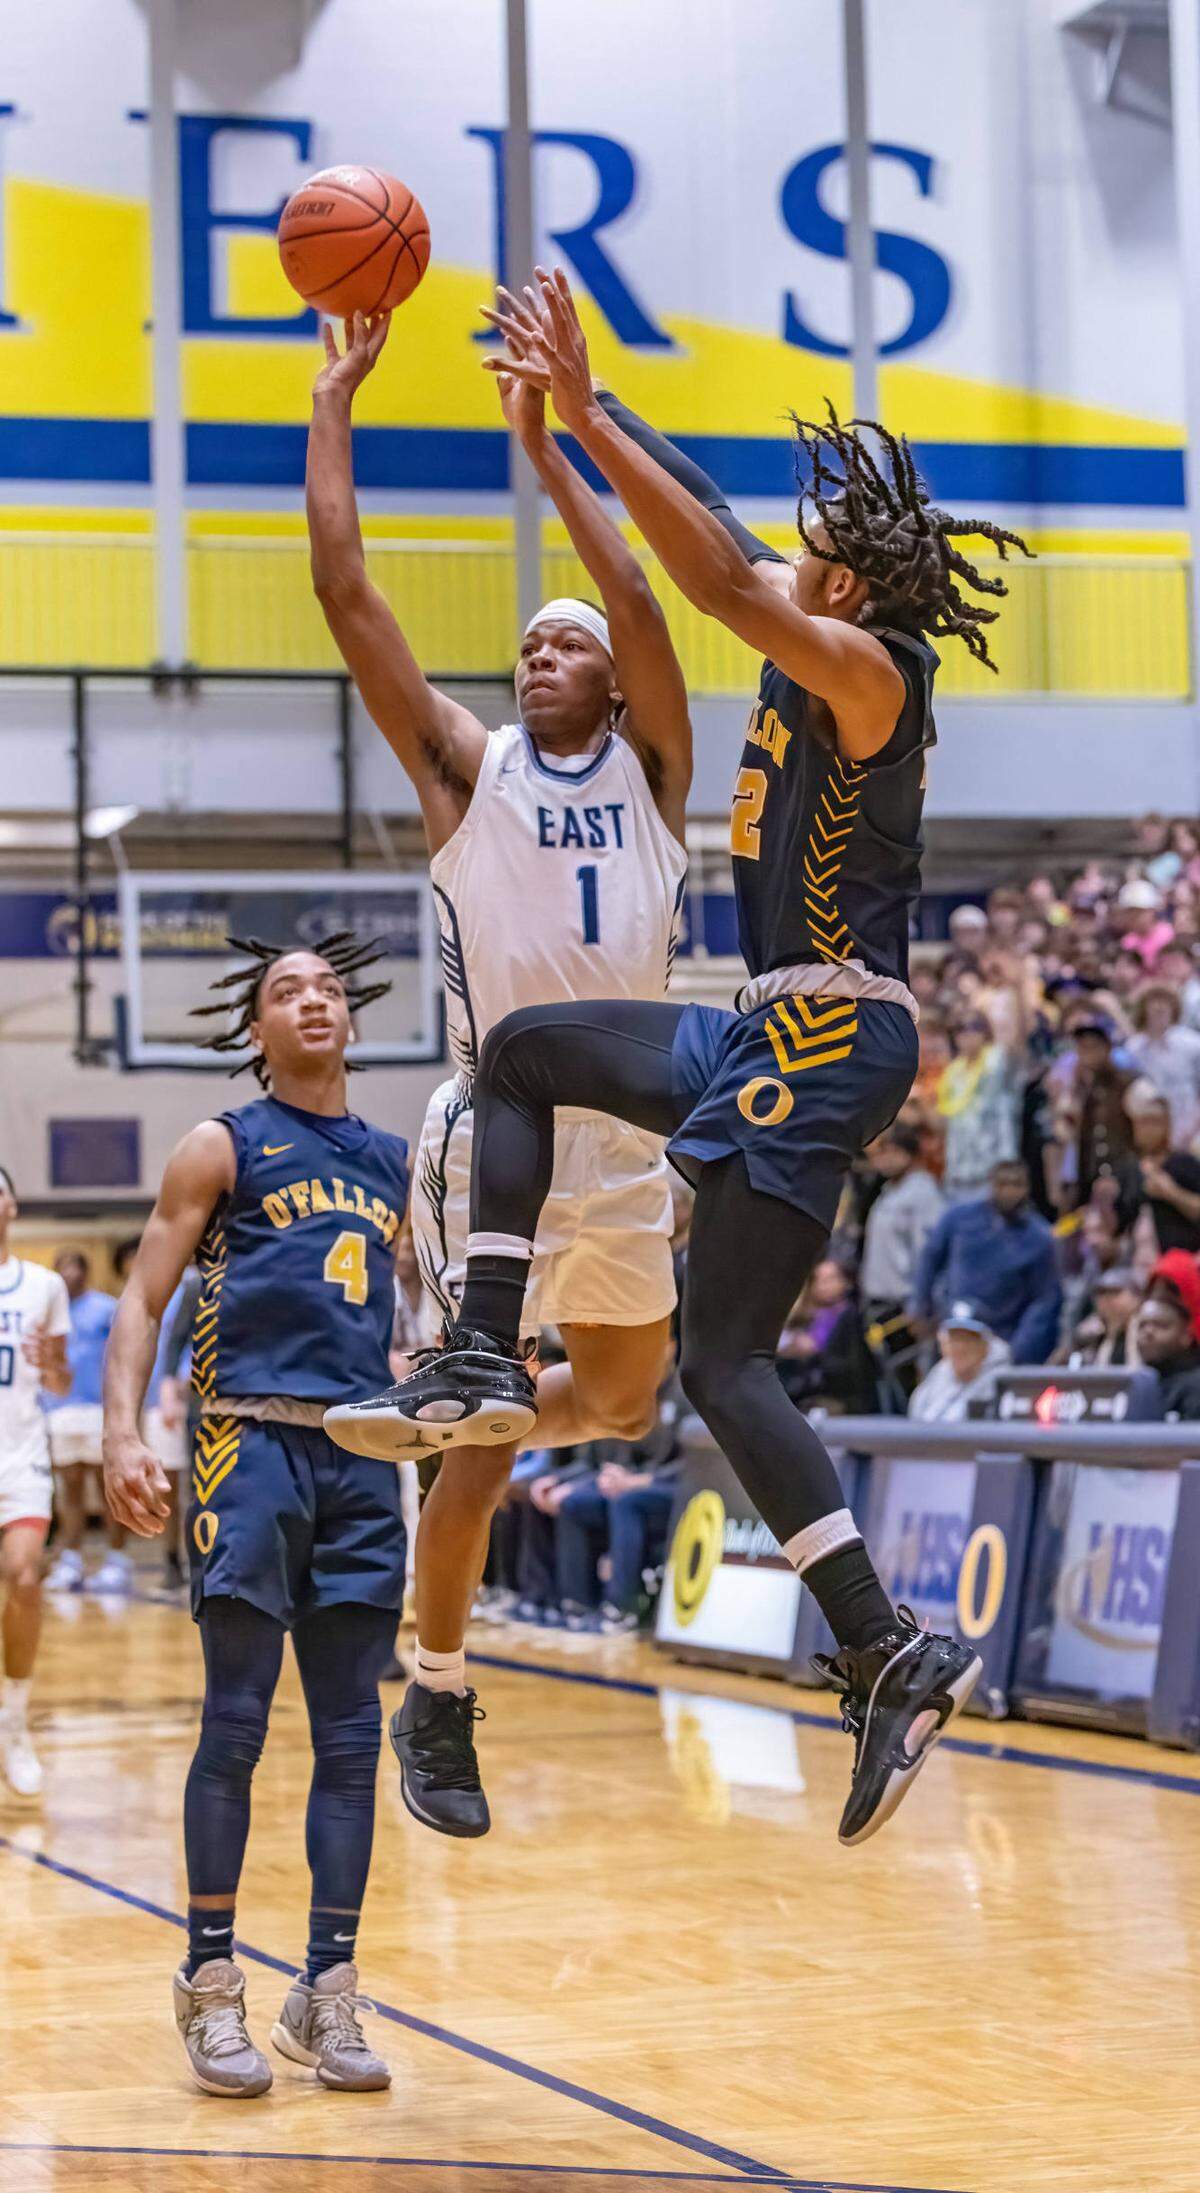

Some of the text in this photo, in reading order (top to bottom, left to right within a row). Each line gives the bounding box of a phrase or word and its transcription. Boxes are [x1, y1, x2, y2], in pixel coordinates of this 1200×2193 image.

[0, 104, 953, 357] ERS
[537, 803, 625, 849] EAST
[575, 864, 599, 945] 1
[737, 1076, 794, 1127] O
[323, 1230, 369, 1307] 4
